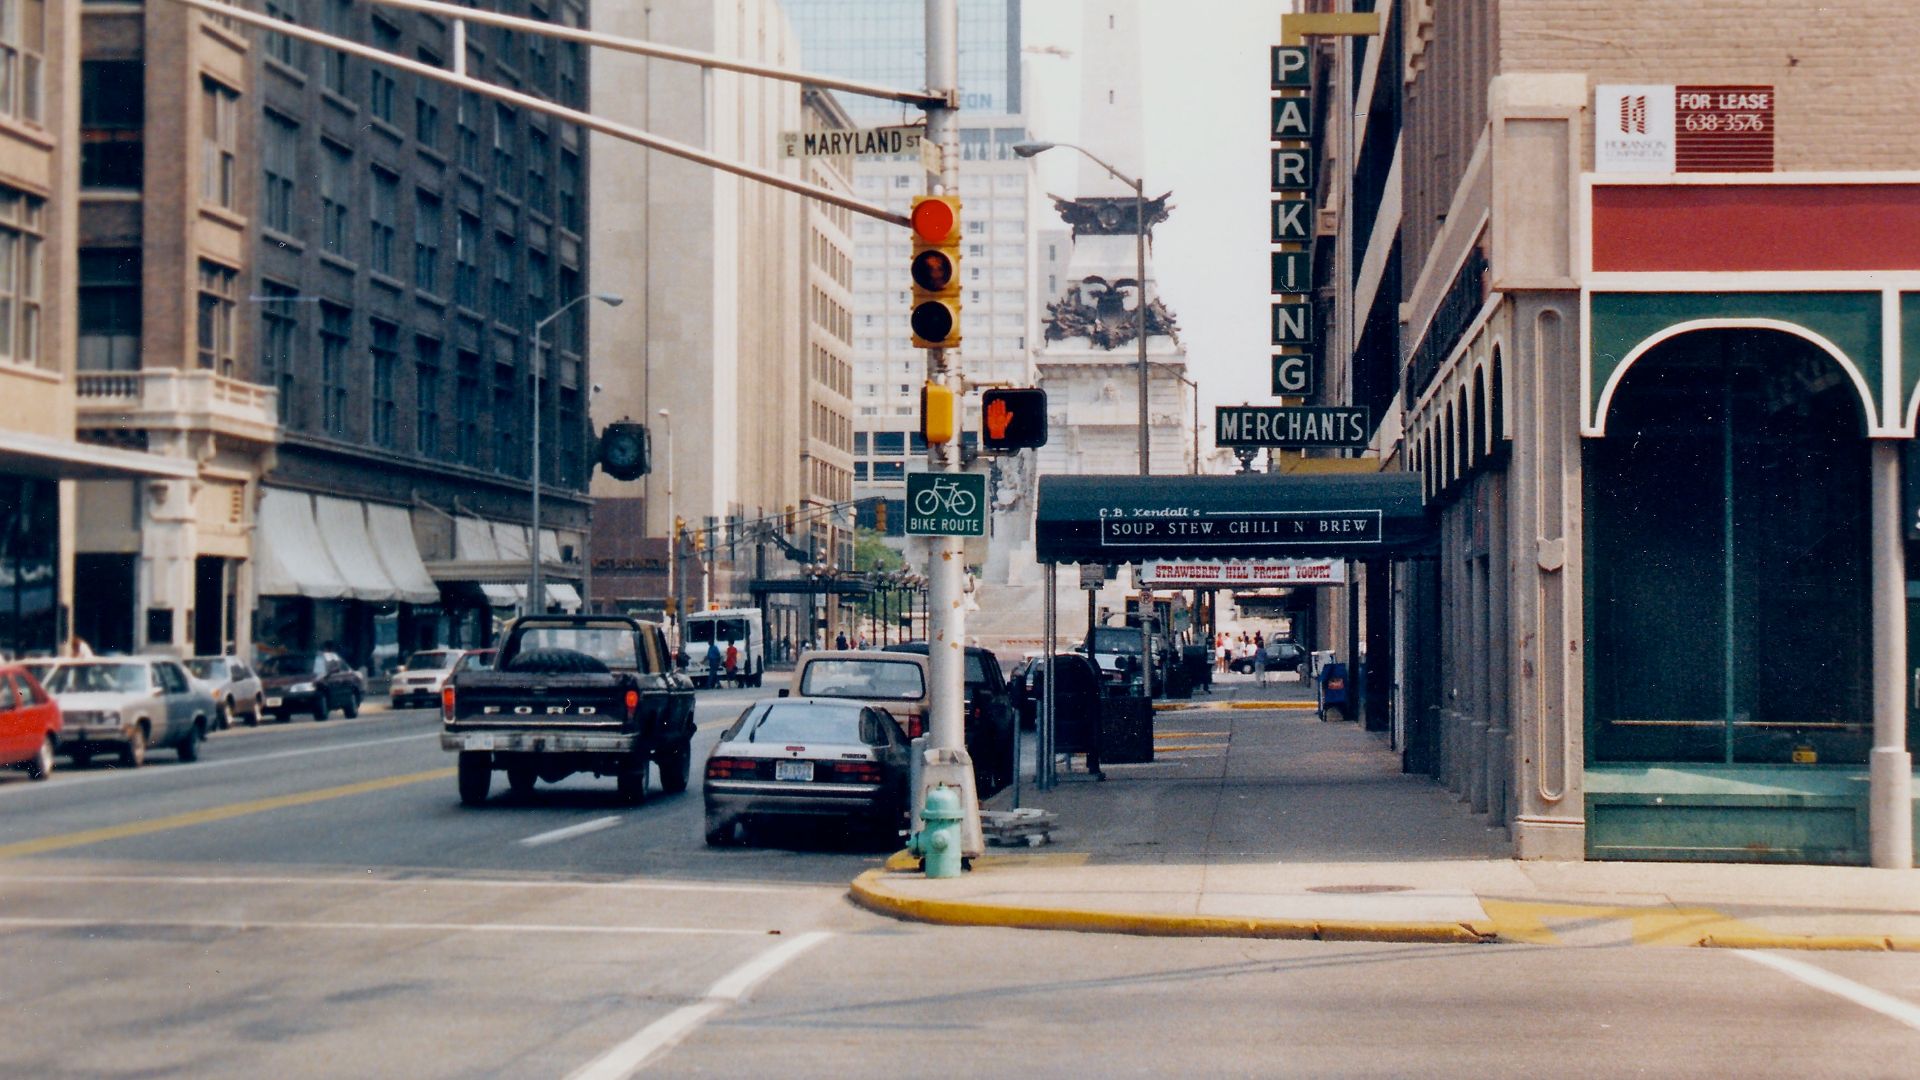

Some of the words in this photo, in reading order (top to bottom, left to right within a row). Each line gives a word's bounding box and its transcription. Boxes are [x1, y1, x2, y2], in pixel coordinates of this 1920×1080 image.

[1680, 94, 1711, 109] FOR
[1719, 94, 1768, 109] LEASE
[1685, 113, 1764, 131] 638-3576
[786, 144, 795, 157] E
[804, 130, 902, 156] MARYLAND
[906, 135, 921, 148] ST
[1276, 49, 1307, 391] PARKING
[1221, 412, 1364, 441] MERCHANTS
[1099, 508, 1128, 518] C.B.
[1133, 507, 1200, 517] Kendall's
[911, 518, 937, 531] BIKE
[941, 518, 979, 532] ROUTE
[1229, 521, 1278, 533] CHILI
[1319, 519, 1368, 532] BREW
[1155, 565, 1221, 579] STRAWBERRY
[1226, 565, 1249, 579] HILL
[1253, 565, 1291, 579] FROZEN
[1295, 565, 1332, 579] YOGURT
[483, 706, 597, 715] FORD
